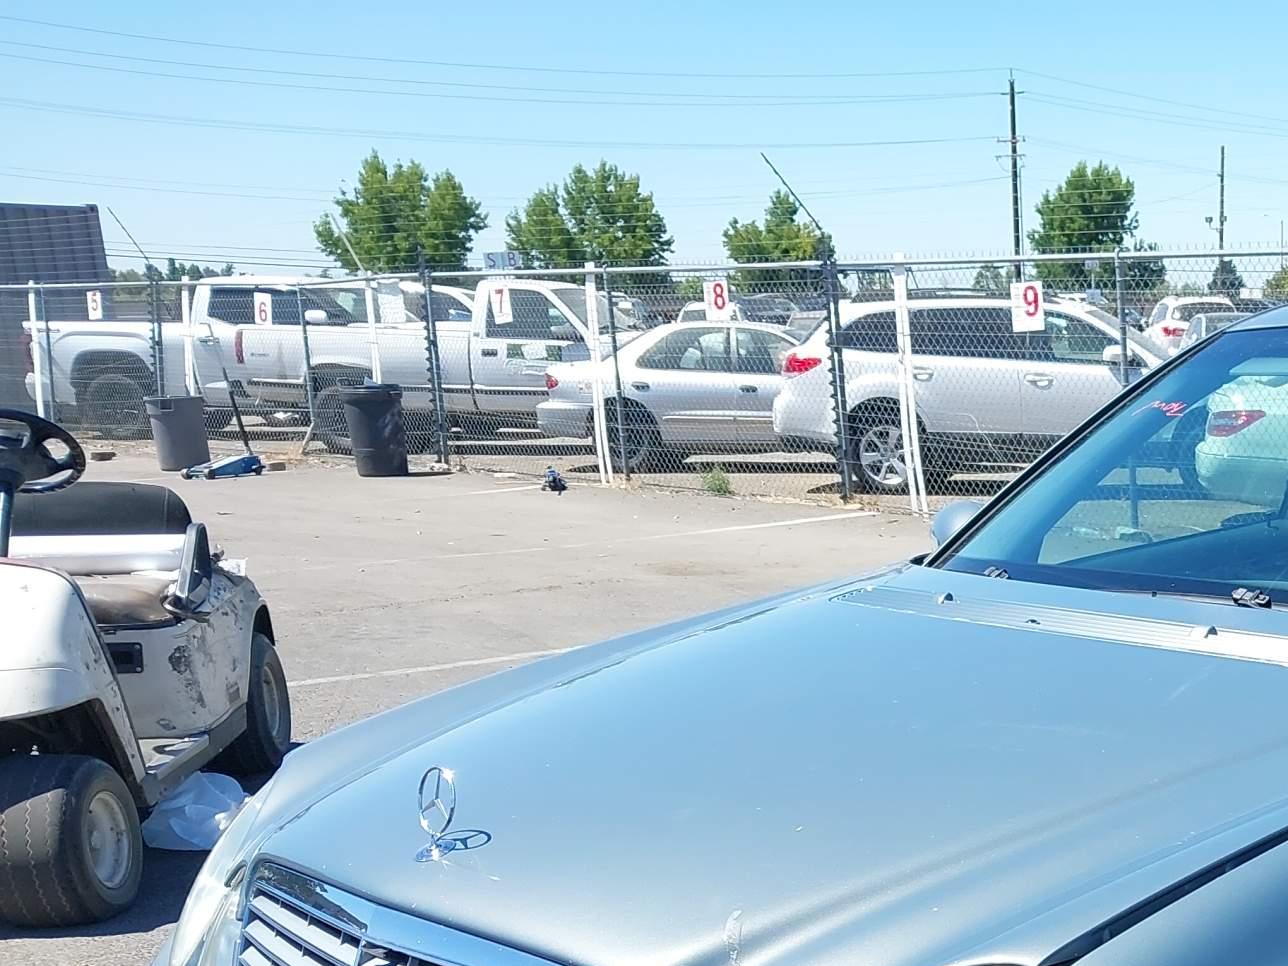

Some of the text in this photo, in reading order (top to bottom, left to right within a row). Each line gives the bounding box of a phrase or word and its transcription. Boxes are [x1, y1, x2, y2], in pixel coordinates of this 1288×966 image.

[90, 291, 98, 311] 5
[494, 288, 504, 313] 7
[713, 282, 726, 310] 8
[1023, 285, 1039, 317] 9
[259, 301, 268, 322] 6
